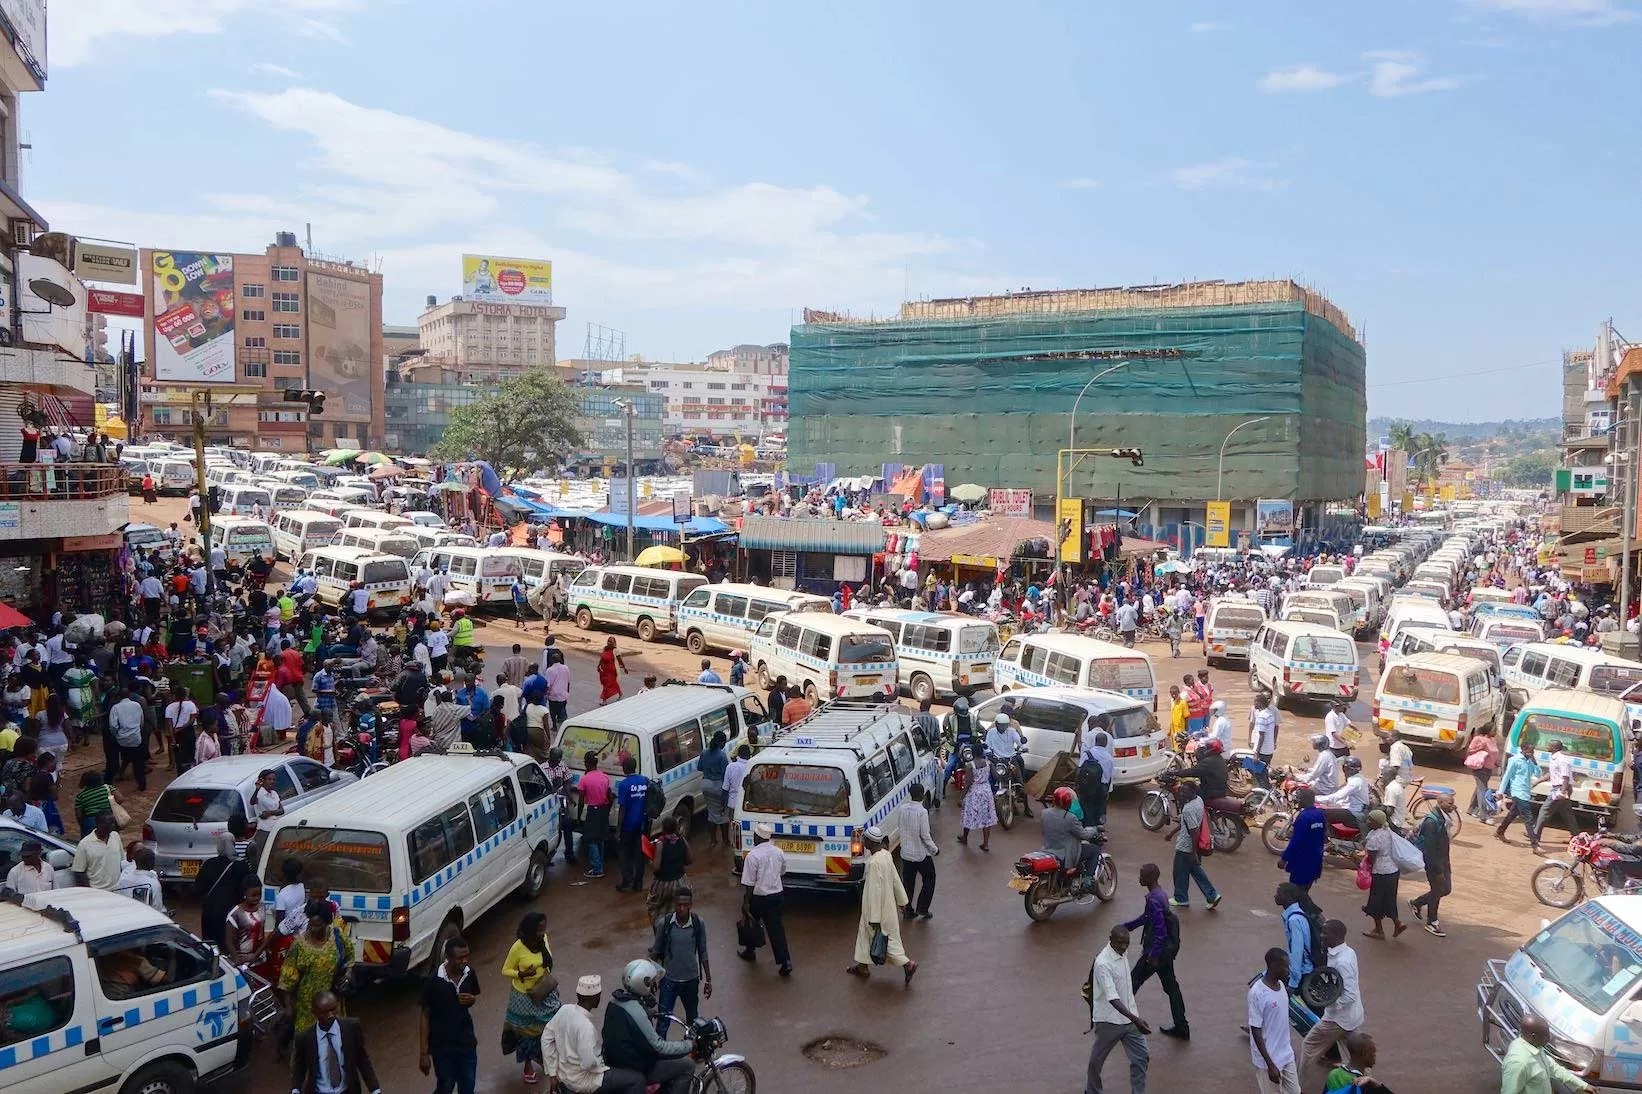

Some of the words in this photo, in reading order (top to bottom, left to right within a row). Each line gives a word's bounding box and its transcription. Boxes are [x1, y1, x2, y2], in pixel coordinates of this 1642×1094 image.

[185, 268, 205, 281] LOW
[470, 303, 512, 315] ASTORIA
[519, 306, 549, 317] HOTEL
[992, 491, 1010, 504] PUBLIC
[1012, 491, 1029, 504] TOILET
[1007, 504, 1023, 512] HOURS
[824, 843, 849, 852] 889P
